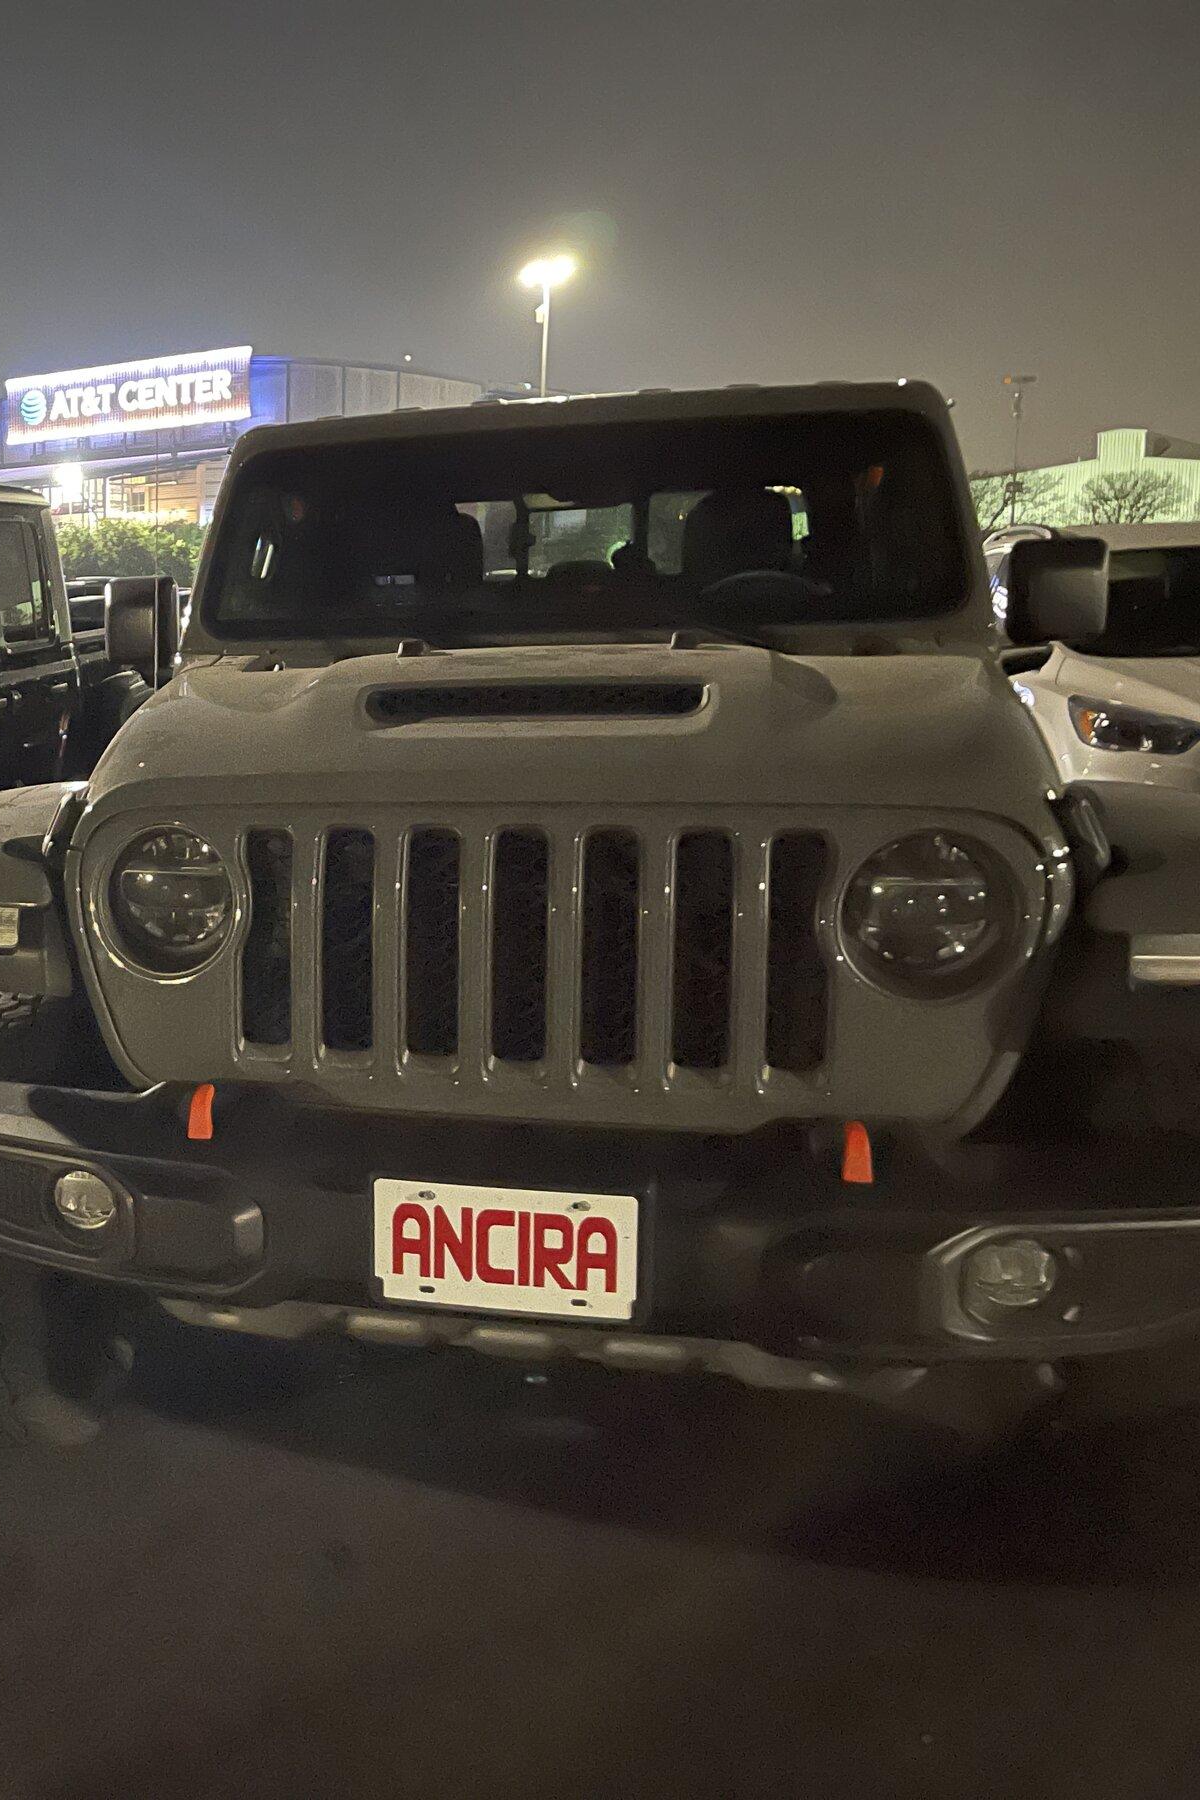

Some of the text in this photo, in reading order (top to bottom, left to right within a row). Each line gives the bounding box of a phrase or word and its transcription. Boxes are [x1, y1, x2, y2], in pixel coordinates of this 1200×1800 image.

[51, 370, 231, 420] AT&T CENTER
[392, 1203, 617, 1293] ANCIRA
